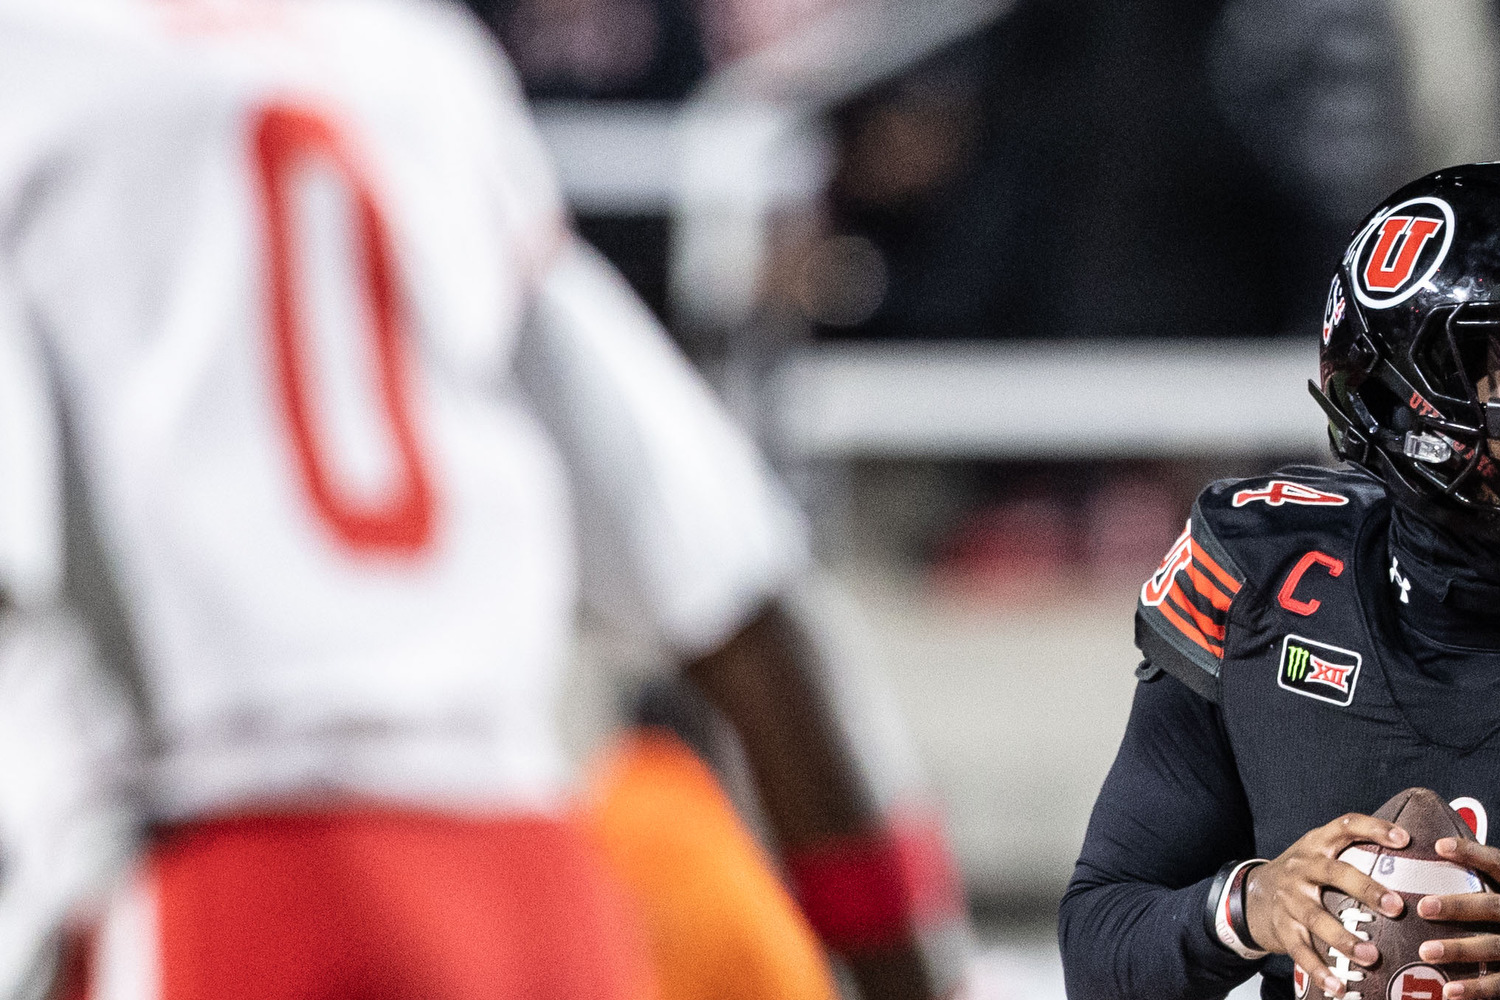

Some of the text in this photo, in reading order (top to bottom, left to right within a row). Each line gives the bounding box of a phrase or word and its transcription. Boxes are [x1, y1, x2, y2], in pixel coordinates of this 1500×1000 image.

[1364, 206, 1444, 293] U
[246, 106, 436, 552] 0
[1232, 480, 1350, 507] 4
[1277, 550, 1345, 617] C
